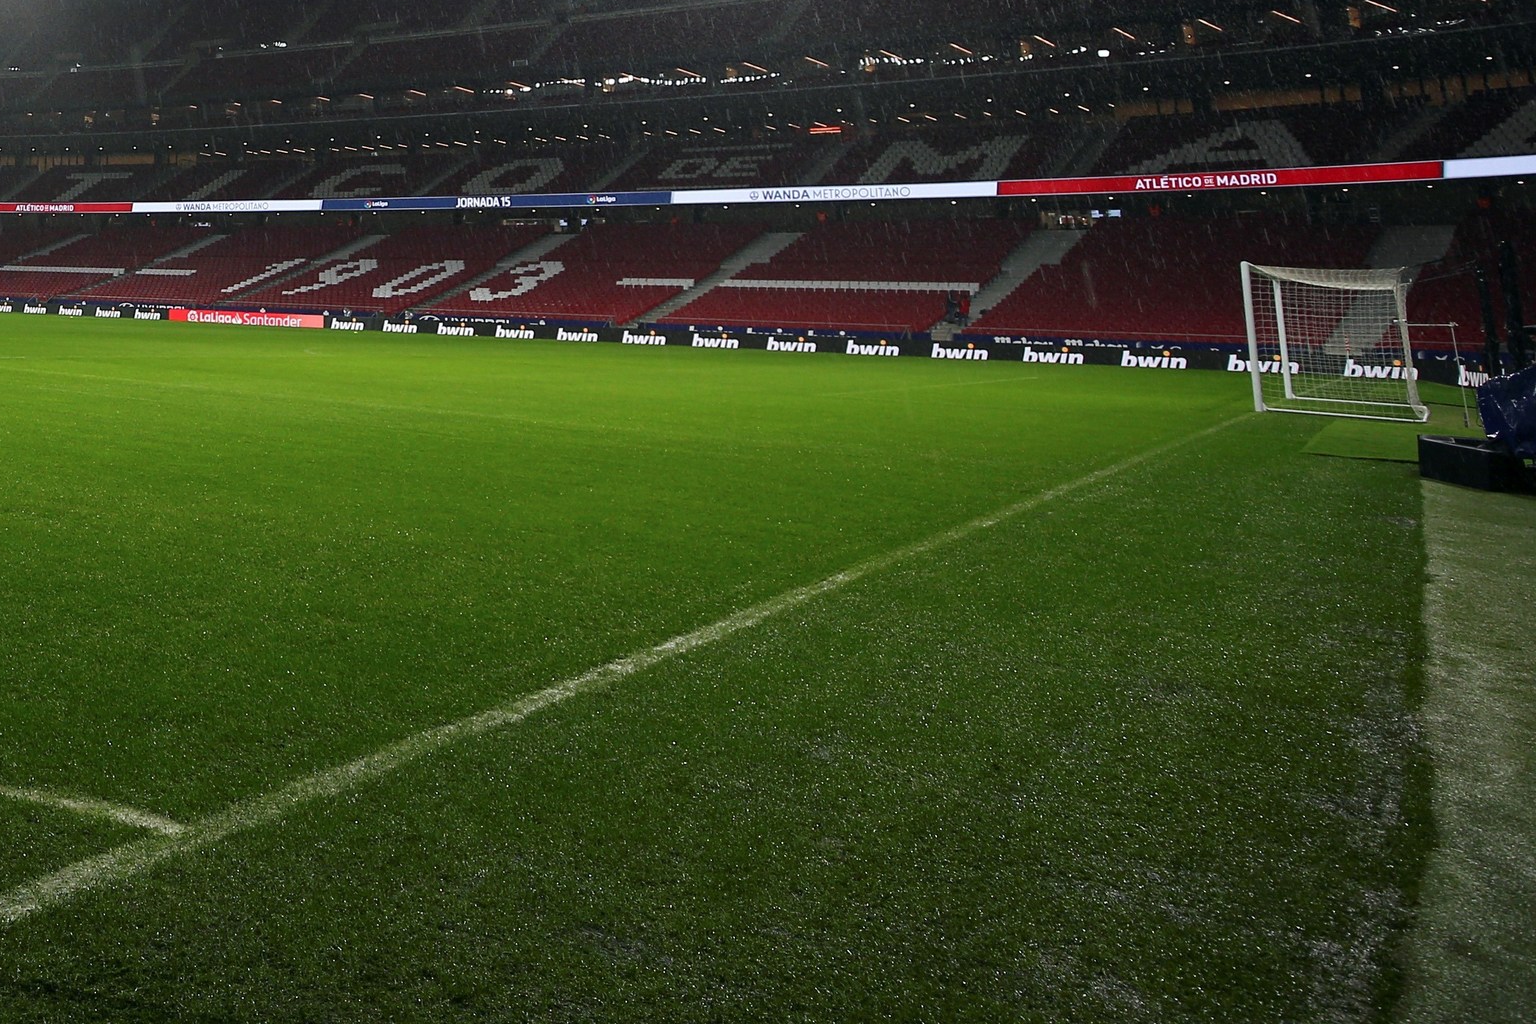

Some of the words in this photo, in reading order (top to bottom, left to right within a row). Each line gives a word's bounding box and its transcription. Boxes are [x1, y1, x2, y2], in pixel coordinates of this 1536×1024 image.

[1135, 176, 1201, 189] ATLÉTICO
[1216, 173, 1277, 187] MADRID
[762, 190, 810, 200] WANDA
[813, 187, 911, 200] METROPOLITANO
[15, 204, 44, 212] ATLÉTICO
[49, 204, 74, 212] MADRID
[183, 203, 211, 211] WANDA
[212, 202, 269, 211] METROPOLITANO
[456, 197, 499, 208] JORNADA
[500, 196, 510, 207] 15
[221, 258, 564, 302] 1903
[199, 312, 232, 325] LaLiga
[243, 314, 302, 328] Santander
[331, 317, 364, 331] bwin
[382, 320, 418, 334] bwin
[437, 322, 474, 336] bwin
[495, 325, 535, 339] bwin
[556, 327, 598, 342] bwin
[622, 330, 666, 345] bwin
[691, 333, 739, 349] bwin
[766, 336, 816, 353] bwin
[845, 339, 900, 357] bwin
[931, 343, 988, 361] bwin
[1023, 346, 1084, 365] bwin
[1121, 350, 1187, 369] bwin
[1344, 359, 1419, 381] bwin
